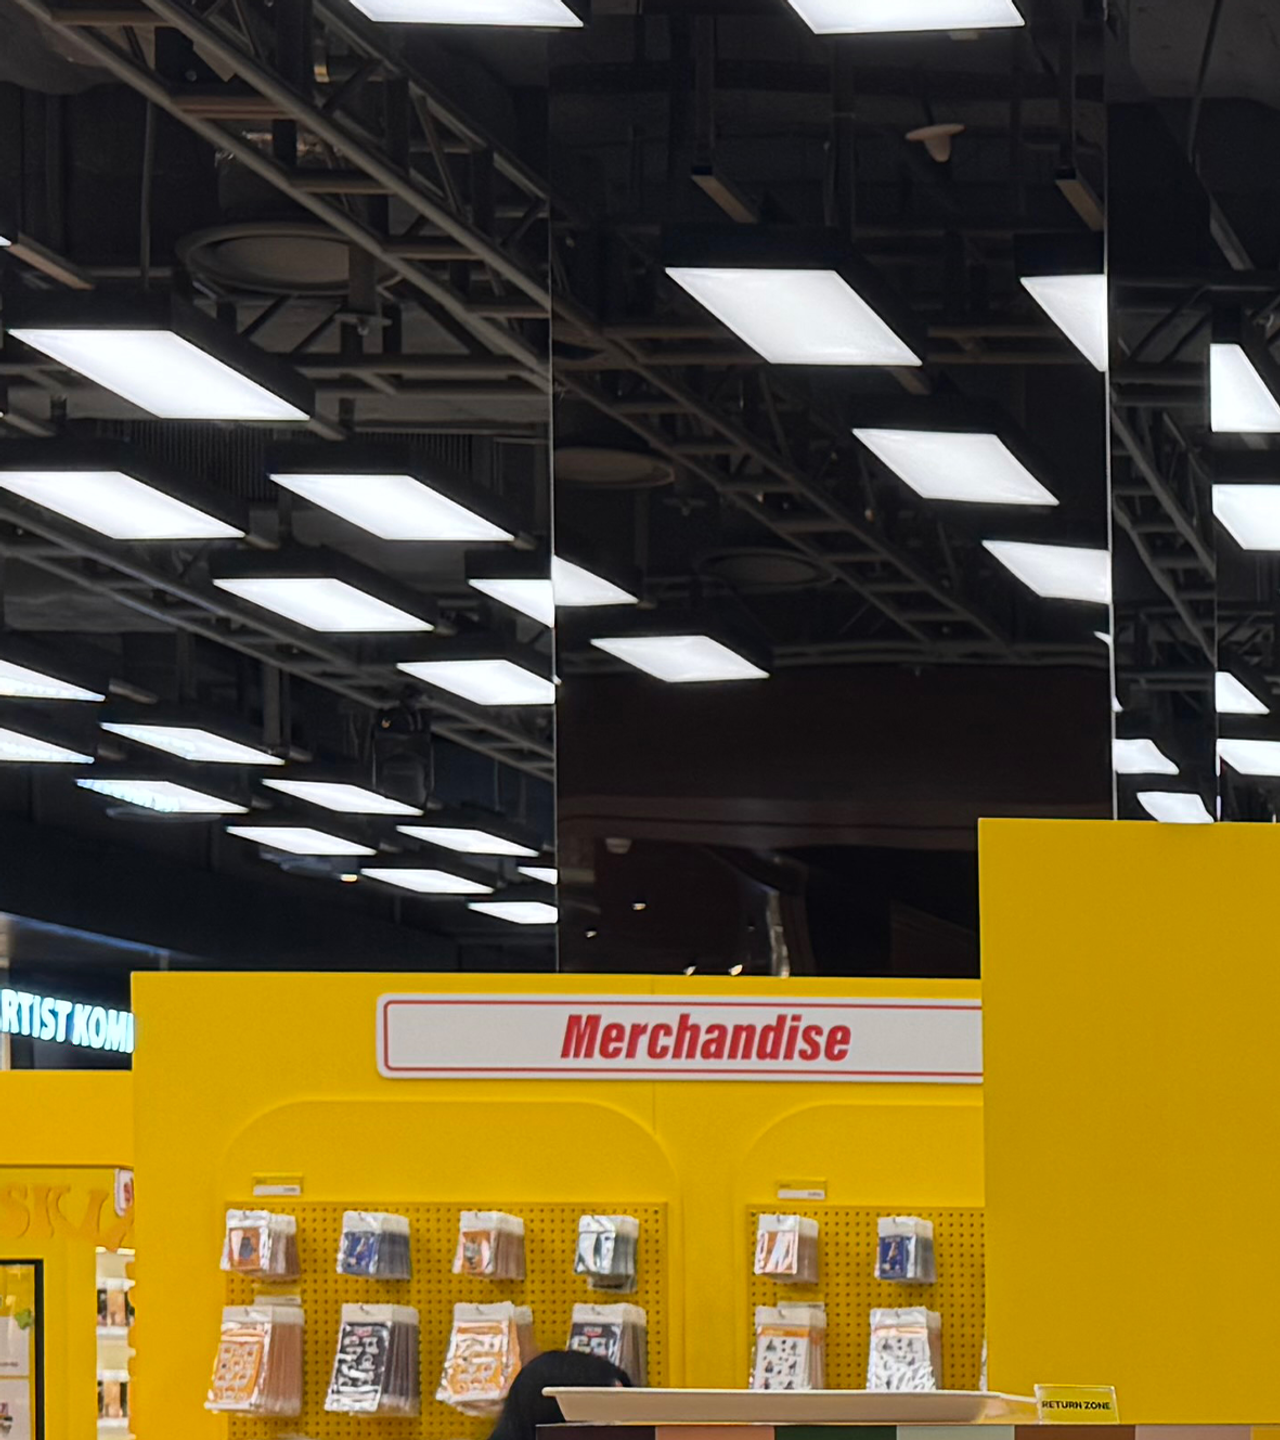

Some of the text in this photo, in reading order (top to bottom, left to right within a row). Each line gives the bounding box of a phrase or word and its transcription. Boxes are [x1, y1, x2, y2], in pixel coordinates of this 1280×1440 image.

[0, 989, 73, 1042] RTIST
[561, 1013, 852, 1062] Merchandise
[1041, 1400, 1111, 1410] RETURN ZONE
